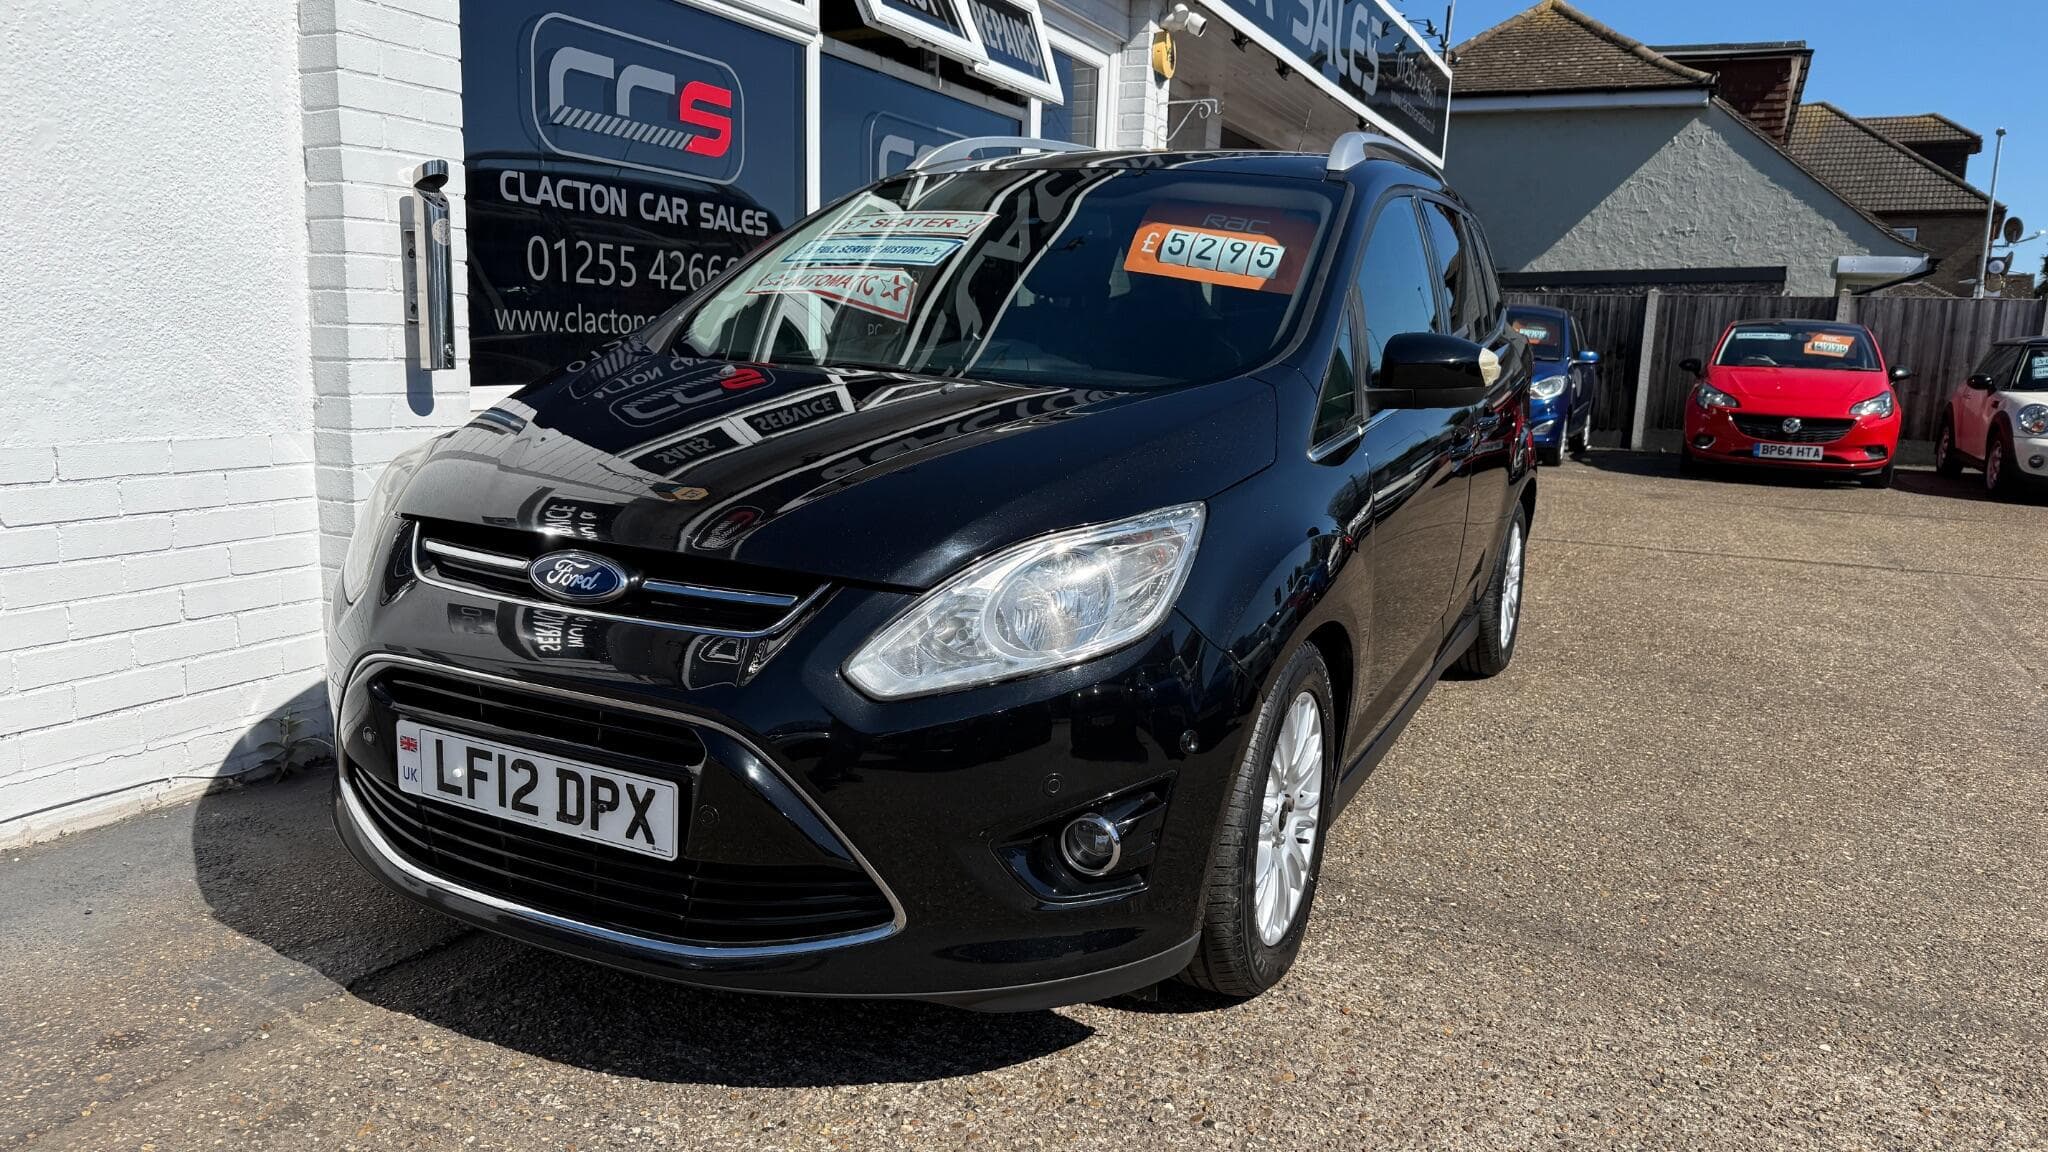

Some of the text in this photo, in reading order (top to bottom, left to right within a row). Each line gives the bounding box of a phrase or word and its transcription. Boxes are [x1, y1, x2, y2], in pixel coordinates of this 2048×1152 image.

[970, 0, 1040, 67] REPAIRS
[499, 169, 769, 237] CLACTON CAR SALES
[869, 217, 959, 230] SEATER
[526, 235, 638, 287] 01255
[815, 244, 926, 255] FULL SERVICE HISTORY
[789, 273, 877, 297] AUTOMATIC
[494, 303, 657, 335] www.clacton
[1761, 444, 1793, 456] BP64
[1796, 446, 1821, 458] HTA
[546, 559, 600, 591] Ford
[402, 764, 419, 784] UK
[434, 738, 657, 846] LF12 DPX
